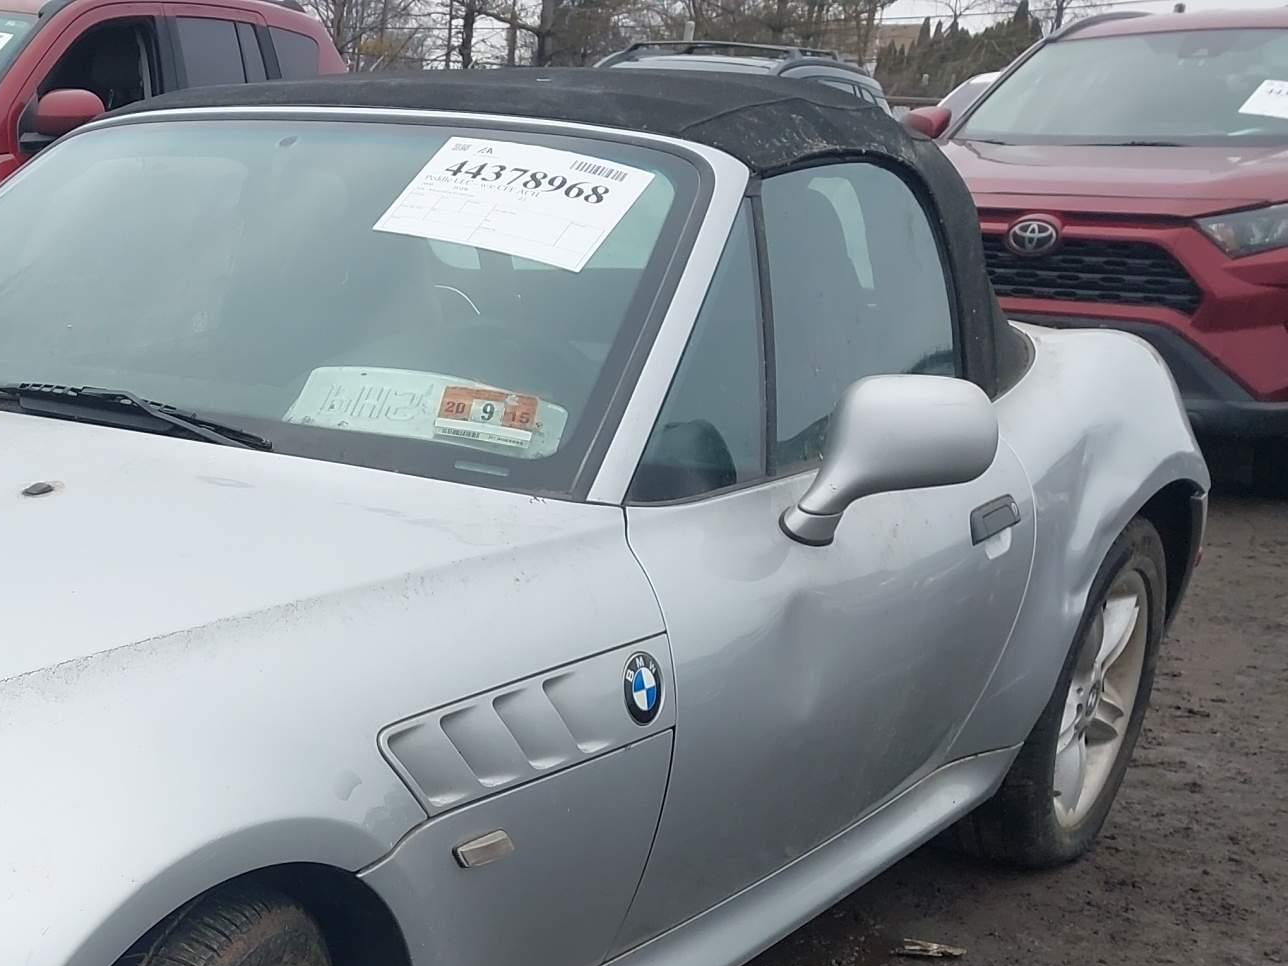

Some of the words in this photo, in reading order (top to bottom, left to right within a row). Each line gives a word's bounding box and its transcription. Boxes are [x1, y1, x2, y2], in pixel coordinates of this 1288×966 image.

[445, 160, 610, 204] 44378968
[480, 402, 495, 421] 9
[625, 655, 657, 683] BMW
